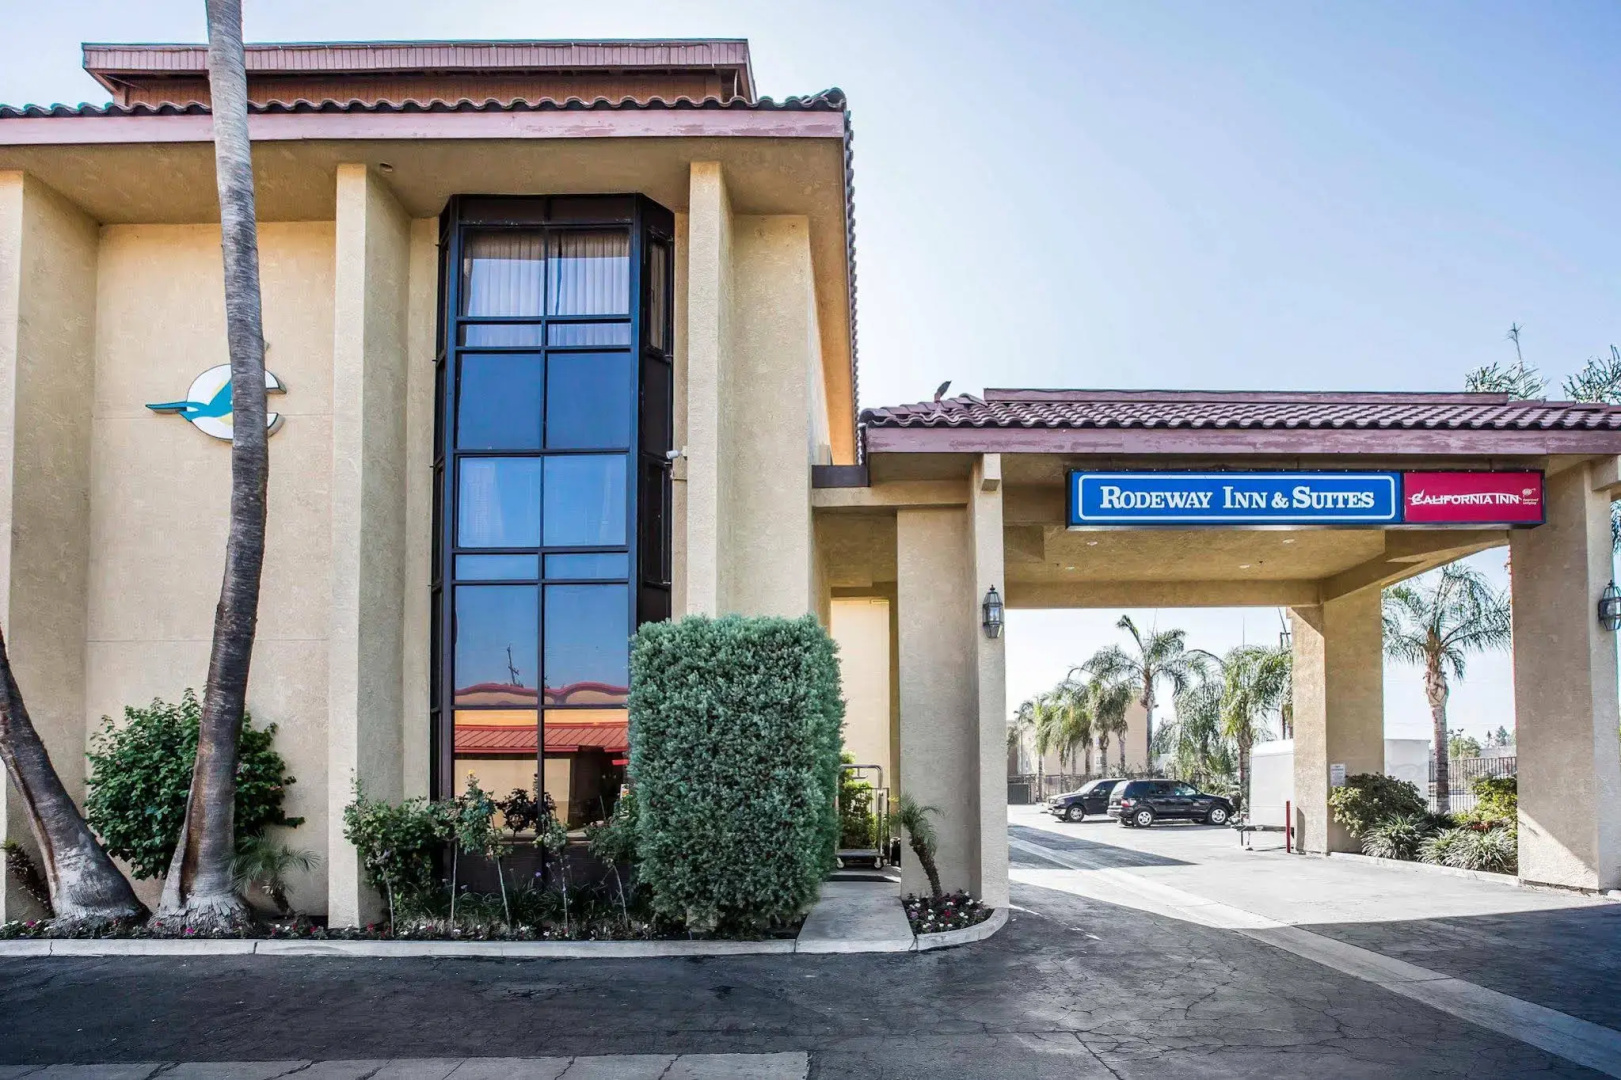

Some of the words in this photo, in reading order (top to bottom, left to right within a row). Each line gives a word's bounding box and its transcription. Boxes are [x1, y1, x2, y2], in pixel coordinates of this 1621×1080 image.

[1100, 485, 1213, 509] RODEWAY
[1222, 486, 1268, 509] INN
[1271, 491, 1290, 509] &
[1292, 485, 1375, 509] SUITES
[1410, 491, 1493, 506] CALIFORNIA
[1495, 493, 1520, 505] INN
